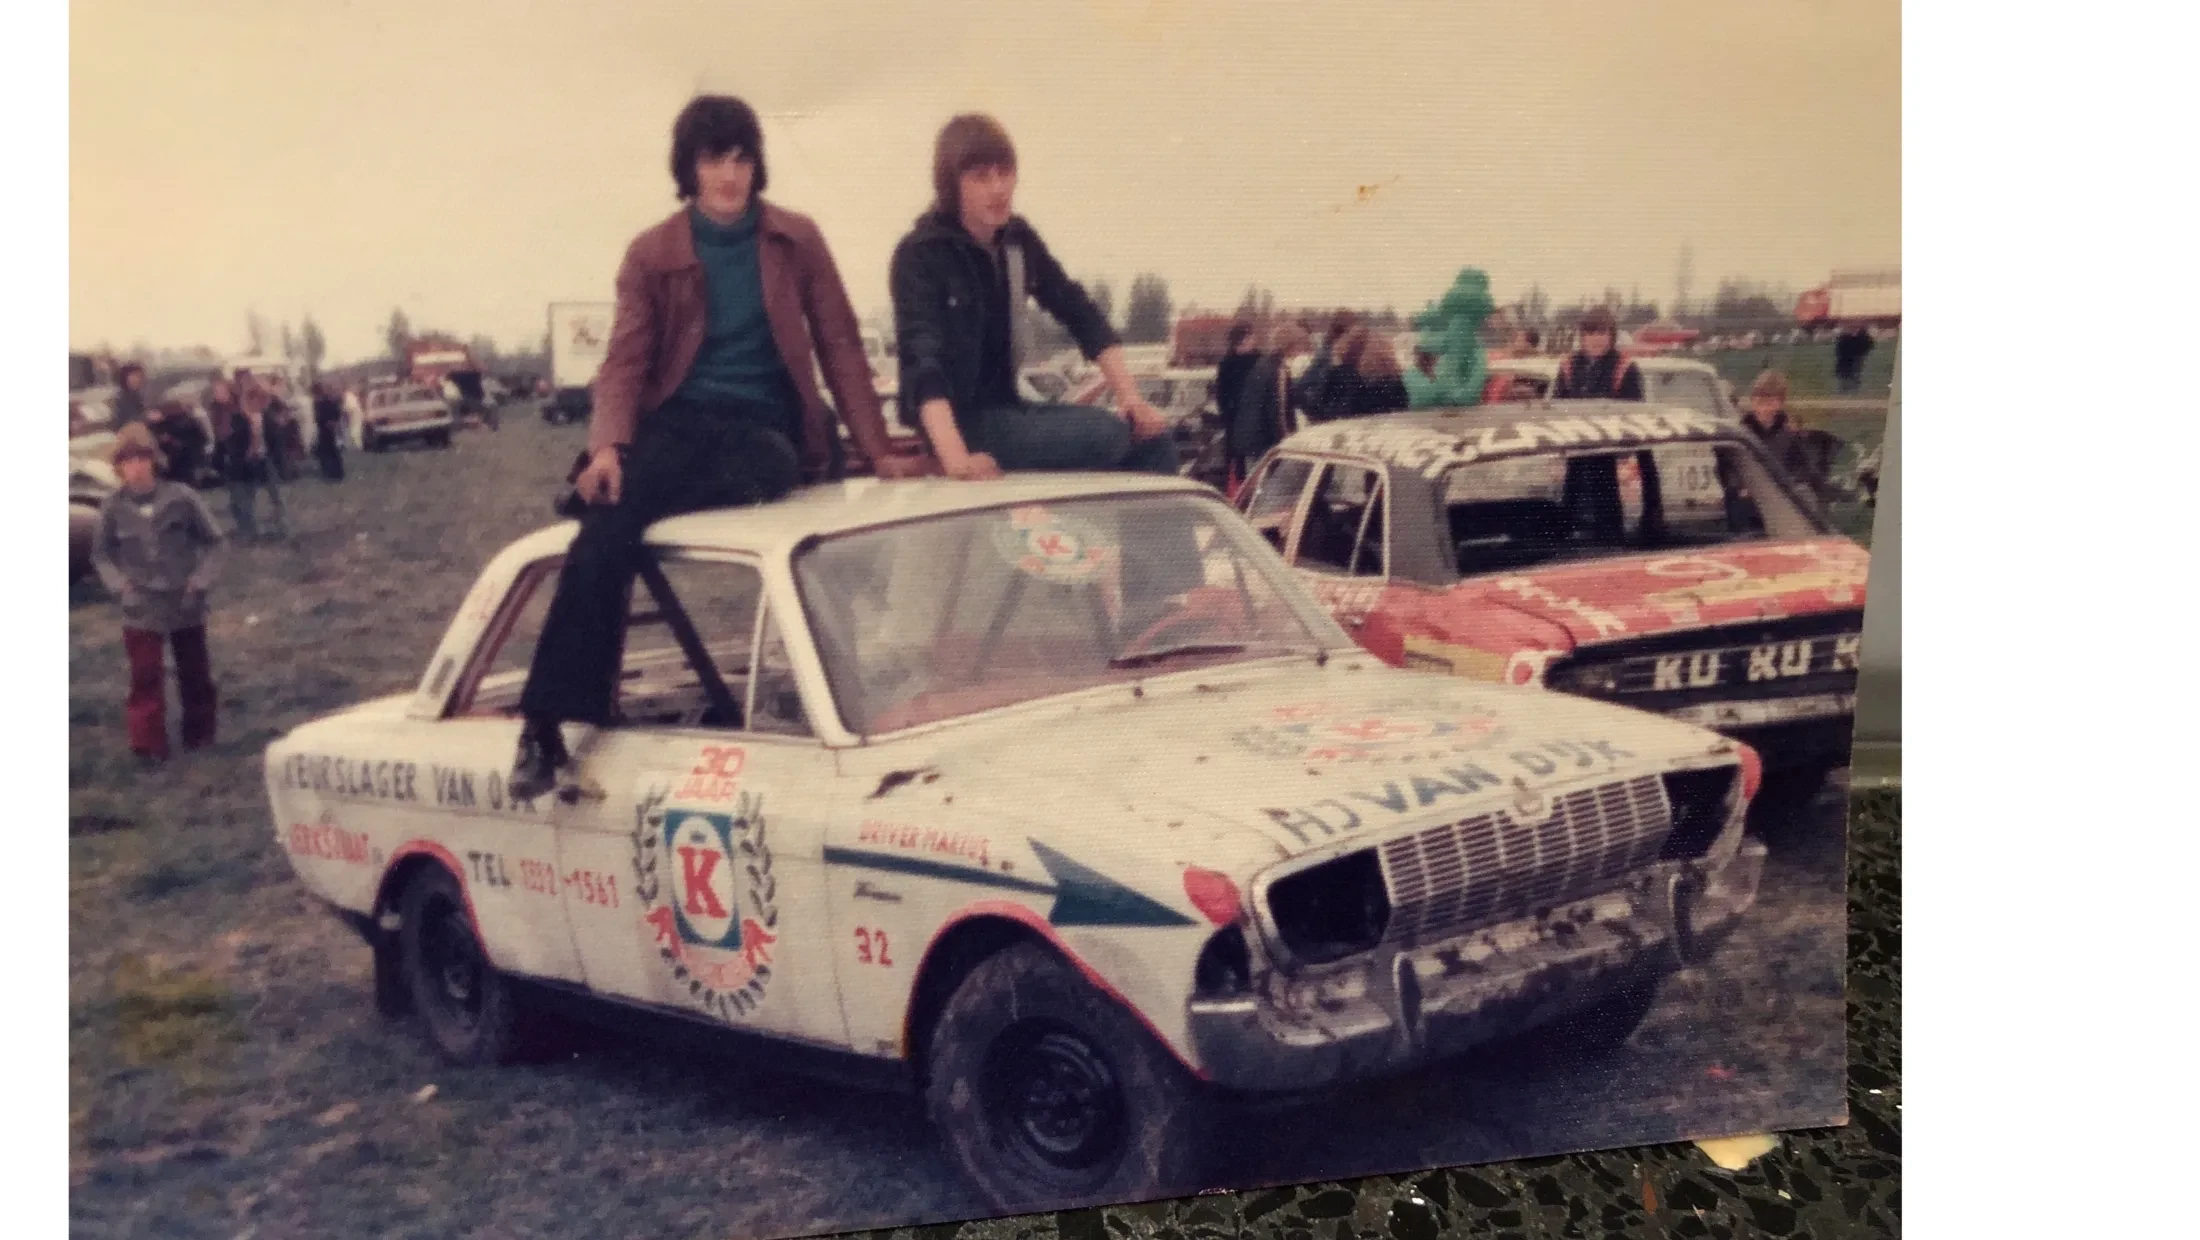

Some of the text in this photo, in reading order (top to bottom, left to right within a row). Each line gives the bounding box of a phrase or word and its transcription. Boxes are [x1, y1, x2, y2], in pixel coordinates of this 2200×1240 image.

[692, 745, 746, 778] 30
[431, 763, 477, 807] VAN
[1348, 763, 1503, 814] VAN
[468, 851, 512, 887] TEL
[676, 846, 729, 920] K
[854, 926, 894, 969] 32
